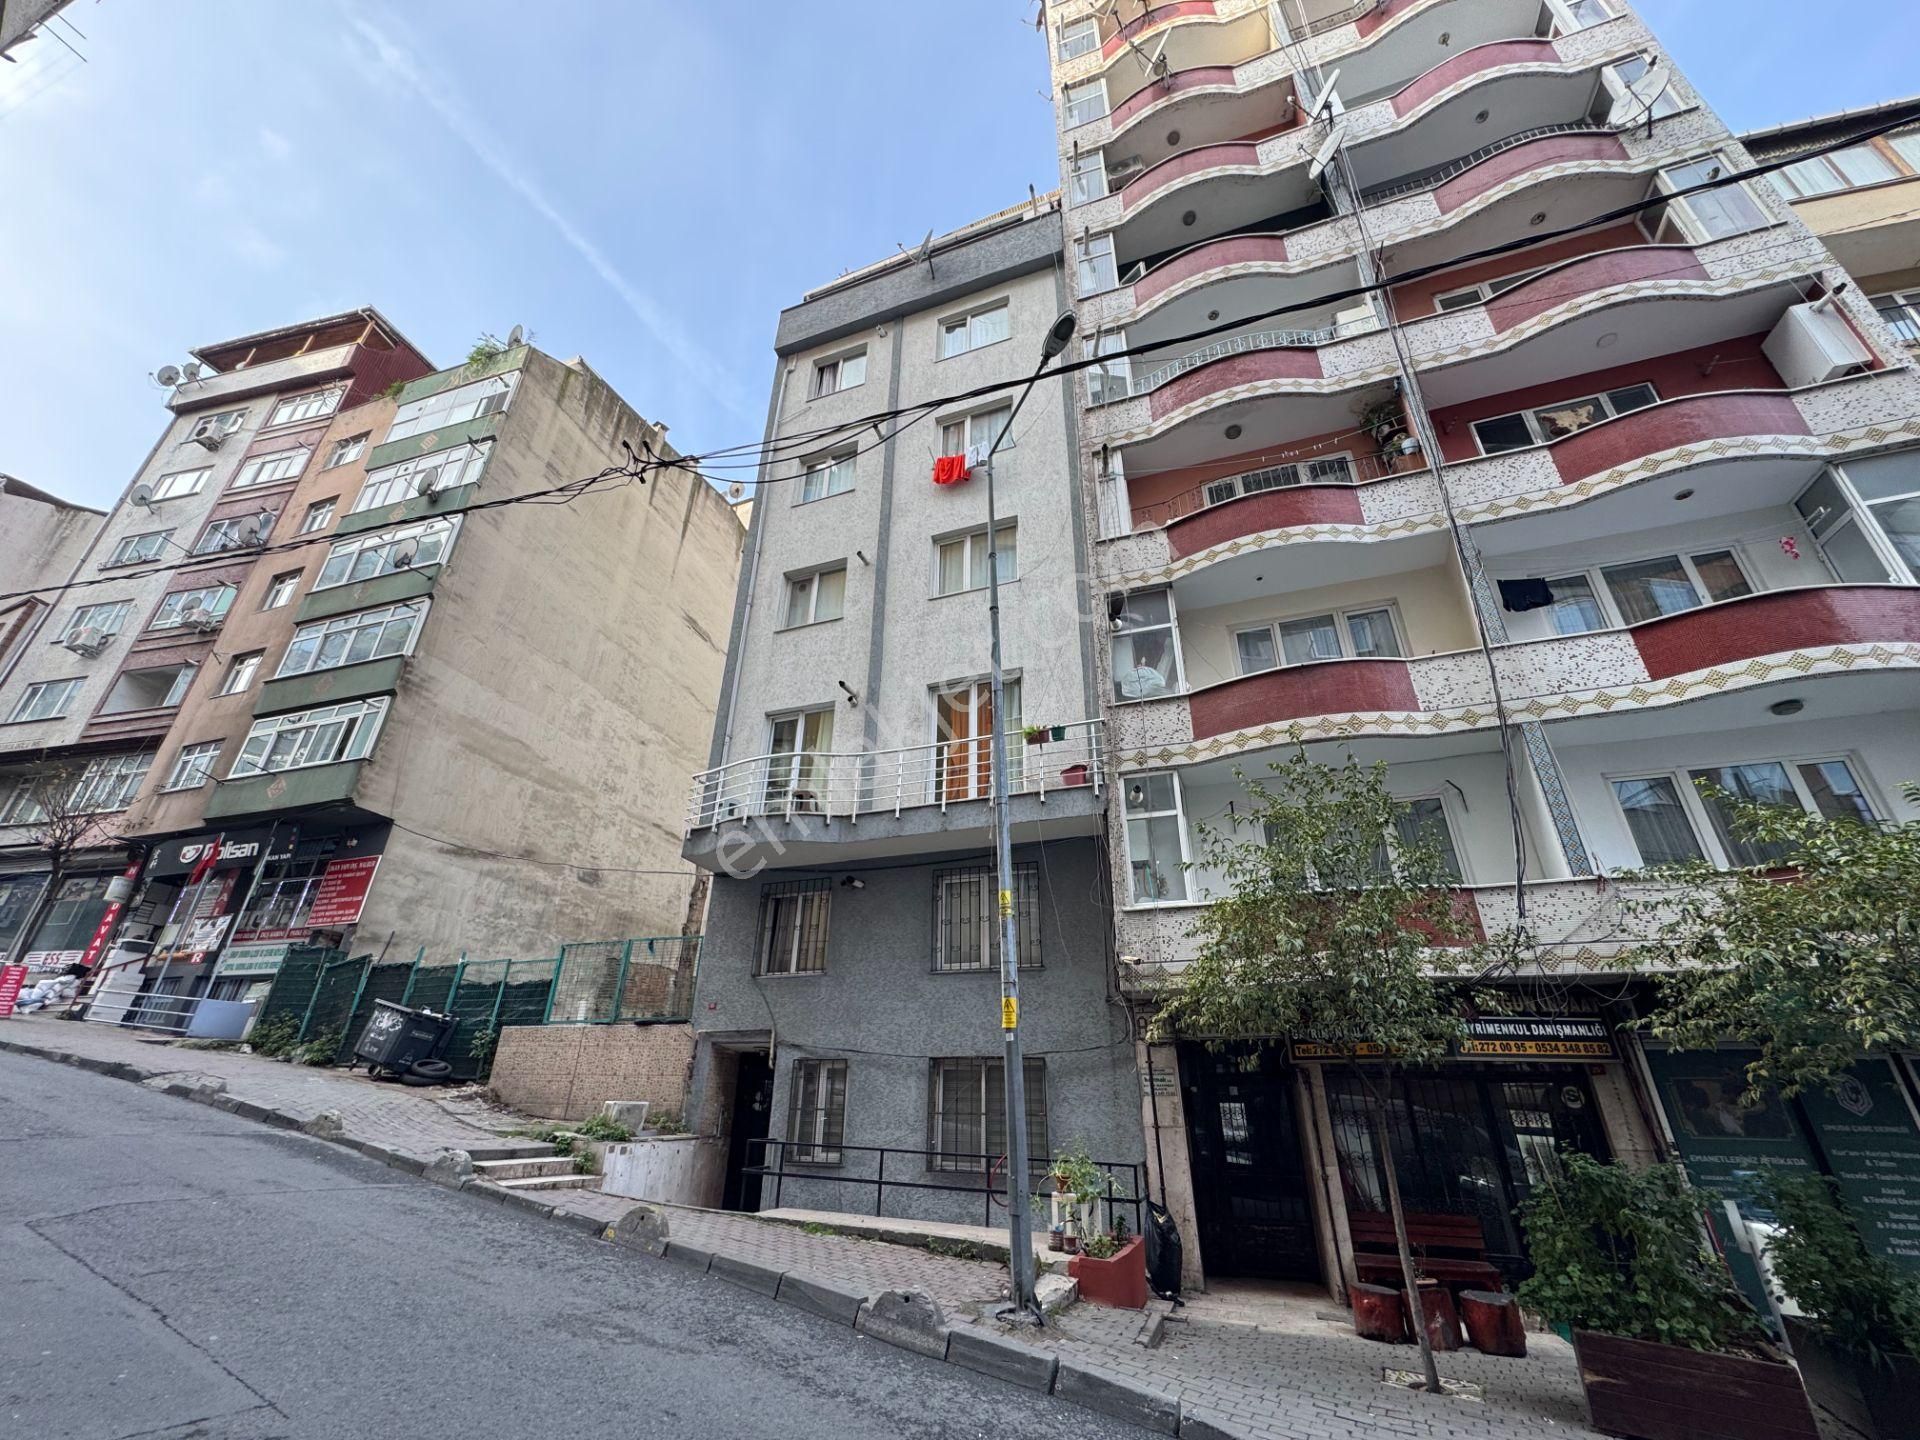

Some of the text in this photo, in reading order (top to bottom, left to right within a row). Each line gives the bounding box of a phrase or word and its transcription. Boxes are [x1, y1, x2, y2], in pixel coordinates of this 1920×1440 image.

[88, 866, 137, 960] HDAVAT
[1459, 1020, 1530, 1036] AYRİMENKUL
[1461, 1041, 1496, 1054] Tl:272
[1499, 1043, 1511, 1053] 00
[1514, 1043, 1527, 1054] 95
[1535, 1043, 1560, 1054] 0534
[1563, 1044, 1581, 1055] 348
[1583, 1044, 1596, 1055] 85
[1597, 1045, 1611, 1055] 82
